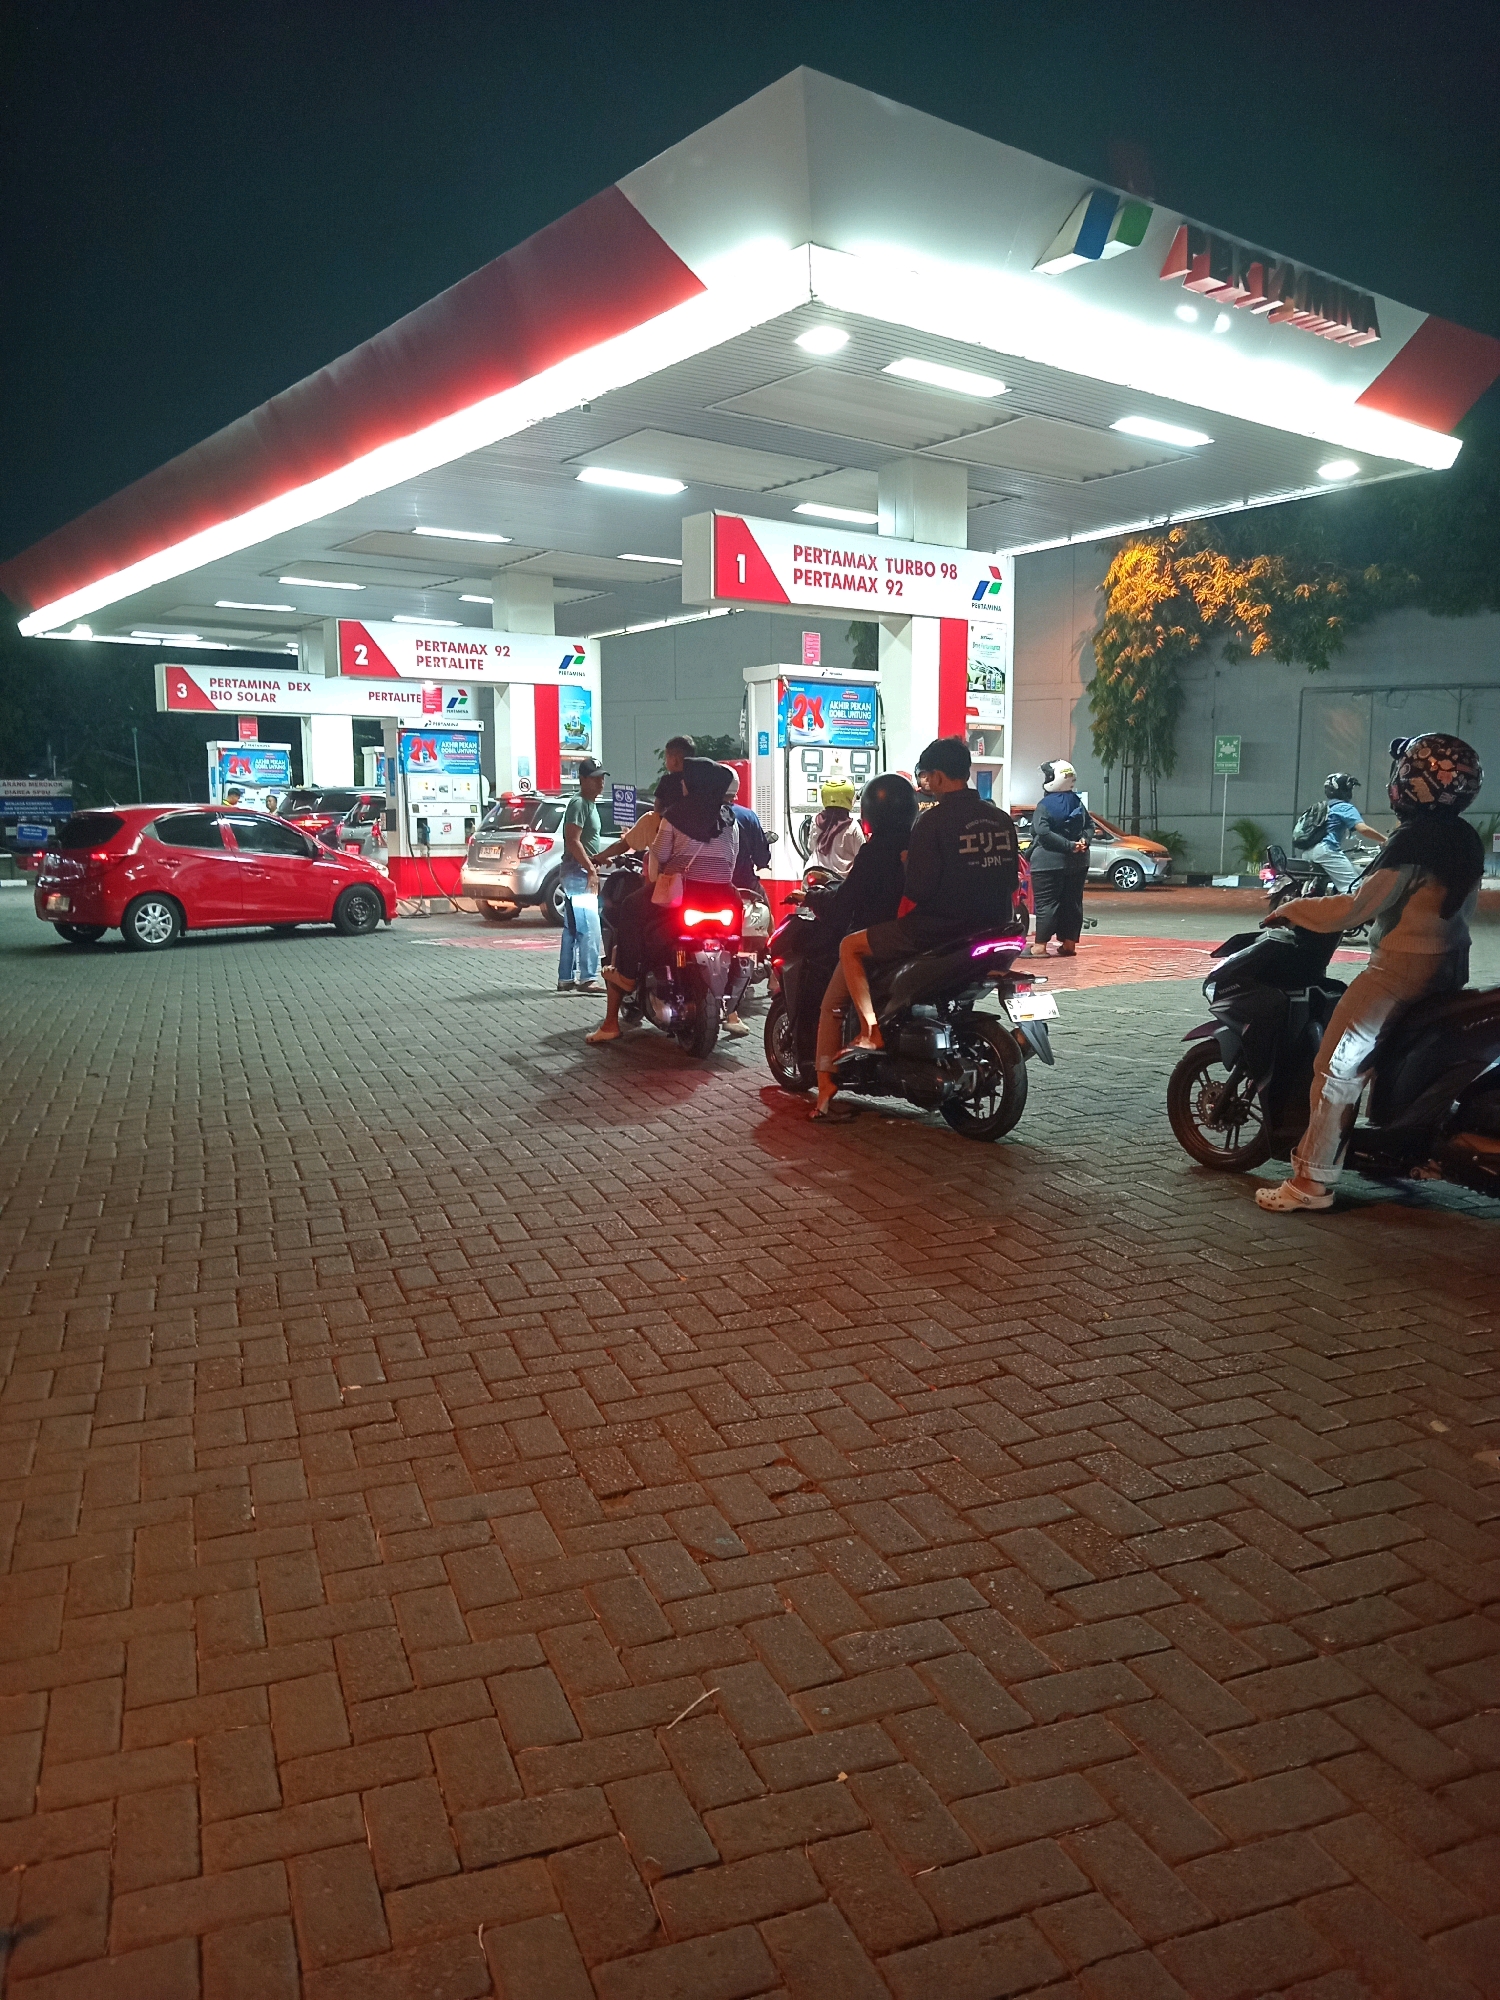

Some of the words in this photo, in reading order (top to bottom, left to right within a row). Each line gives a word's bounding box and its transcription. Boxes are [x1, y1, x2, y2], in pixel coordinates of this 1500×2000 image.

[736, 553, 746, 584] 1
[793, 544, 878, 571] PERTAMAX
[885, 557, 936, 577] TURBO
[941, 563, 957, 580] 98
[793, 568, 878, 593] PERTAMAX
[886, 579, 904, 596] 92
[971, 602, 1002, 612] PERTAMINA
[353, 643, 369, 666] 2
[415, 639, 488, 656] PERTAMAX
[495, 645, 511, 657] 92
[416, 655, 484, 670] PERTALITE
[176, 682, 188, 699] 3
[209, 677, 281, 690] PERTAMINA
[287, 681, 311, 692] DEX
[210, 690, 233, 701] BIO
[237, 691, 277, 703] SOLAR
[368, 691, 422, 703] PERTALITE
[791, 693, 824, 729] 2X
[829, 700, 849, 711] AKHIR
[850, 702, 872, 712] PEKAN
[848, 710, 872, 720] UNTUNG
[410, 737, 438, 762] 2X
[981, 855, 1002, 868] JPN
